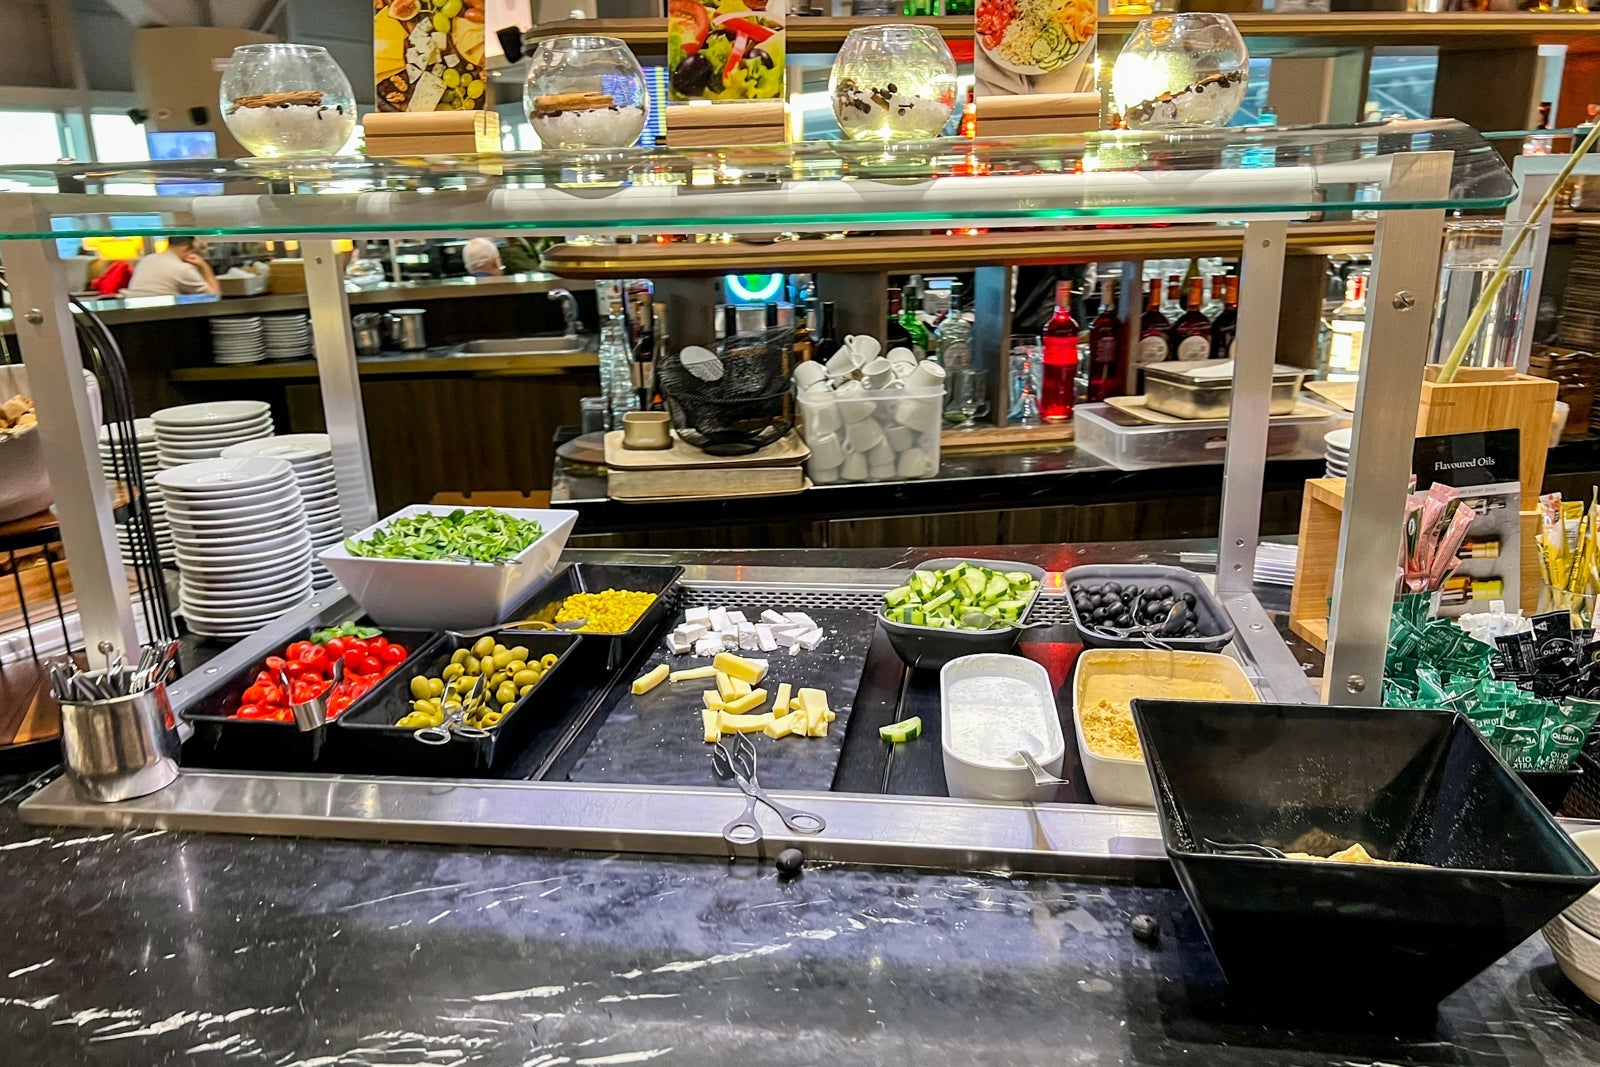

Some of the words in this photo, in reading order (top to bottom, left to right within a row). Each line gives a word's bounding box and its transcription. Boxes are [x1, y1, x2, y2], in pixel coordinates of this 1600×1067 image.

[1434, 458, 1477, 471] Flavoured
[1477, 456, 1496, 467] Oils
[1552, 732, 1579, 743] OLITALIA
